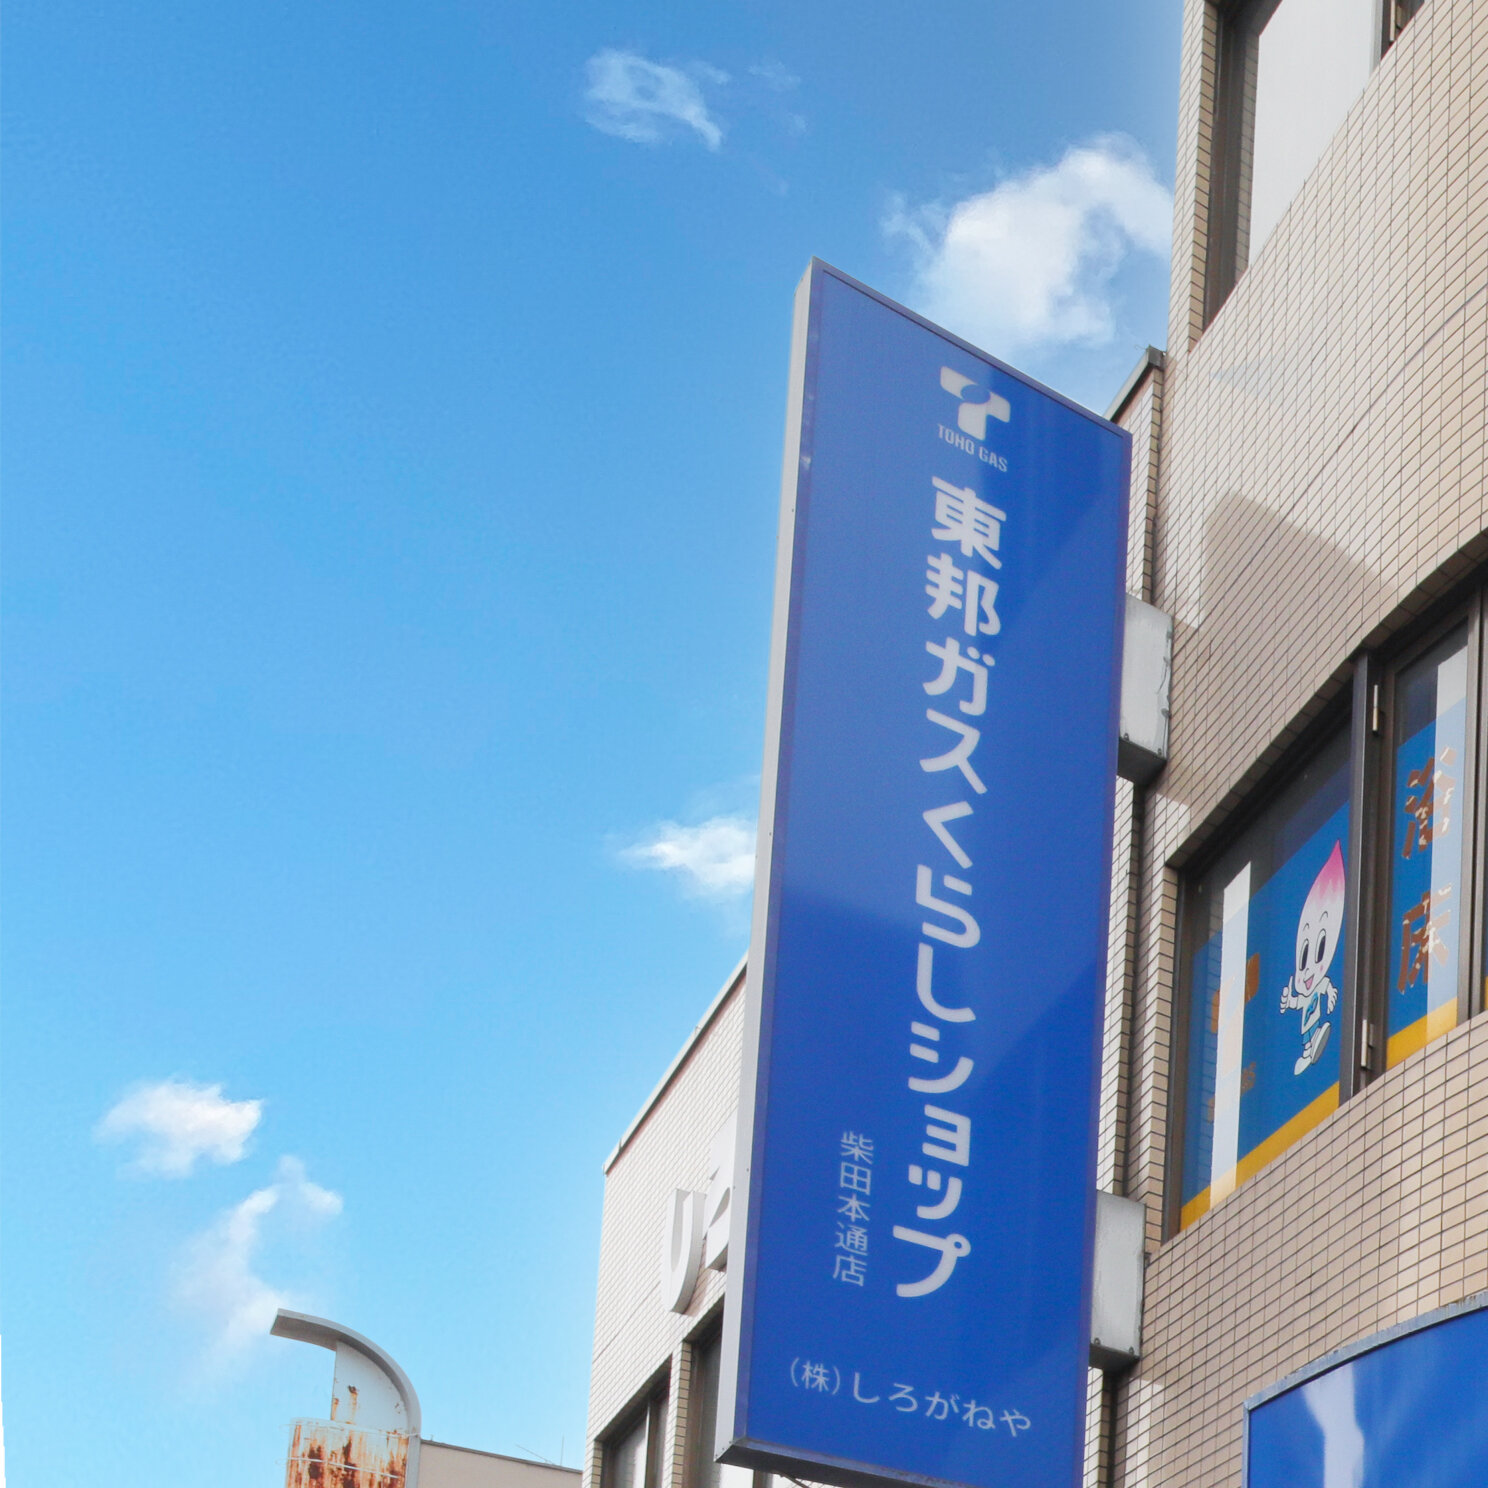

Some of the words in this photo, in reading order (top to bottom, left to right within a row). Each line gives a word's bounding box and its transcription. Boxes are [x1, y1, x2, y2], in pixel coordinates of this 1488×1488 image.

[937, 424, 974, 456] TOHO
[979, 445, 1008, 473] GAS
[893, 475, 1007, 1297] 東邦ガスくらしショップ
[832, 1130, 874, 1288] 柴田本通店
[789, 1357, 1032, 1438] (株)しろがねや
